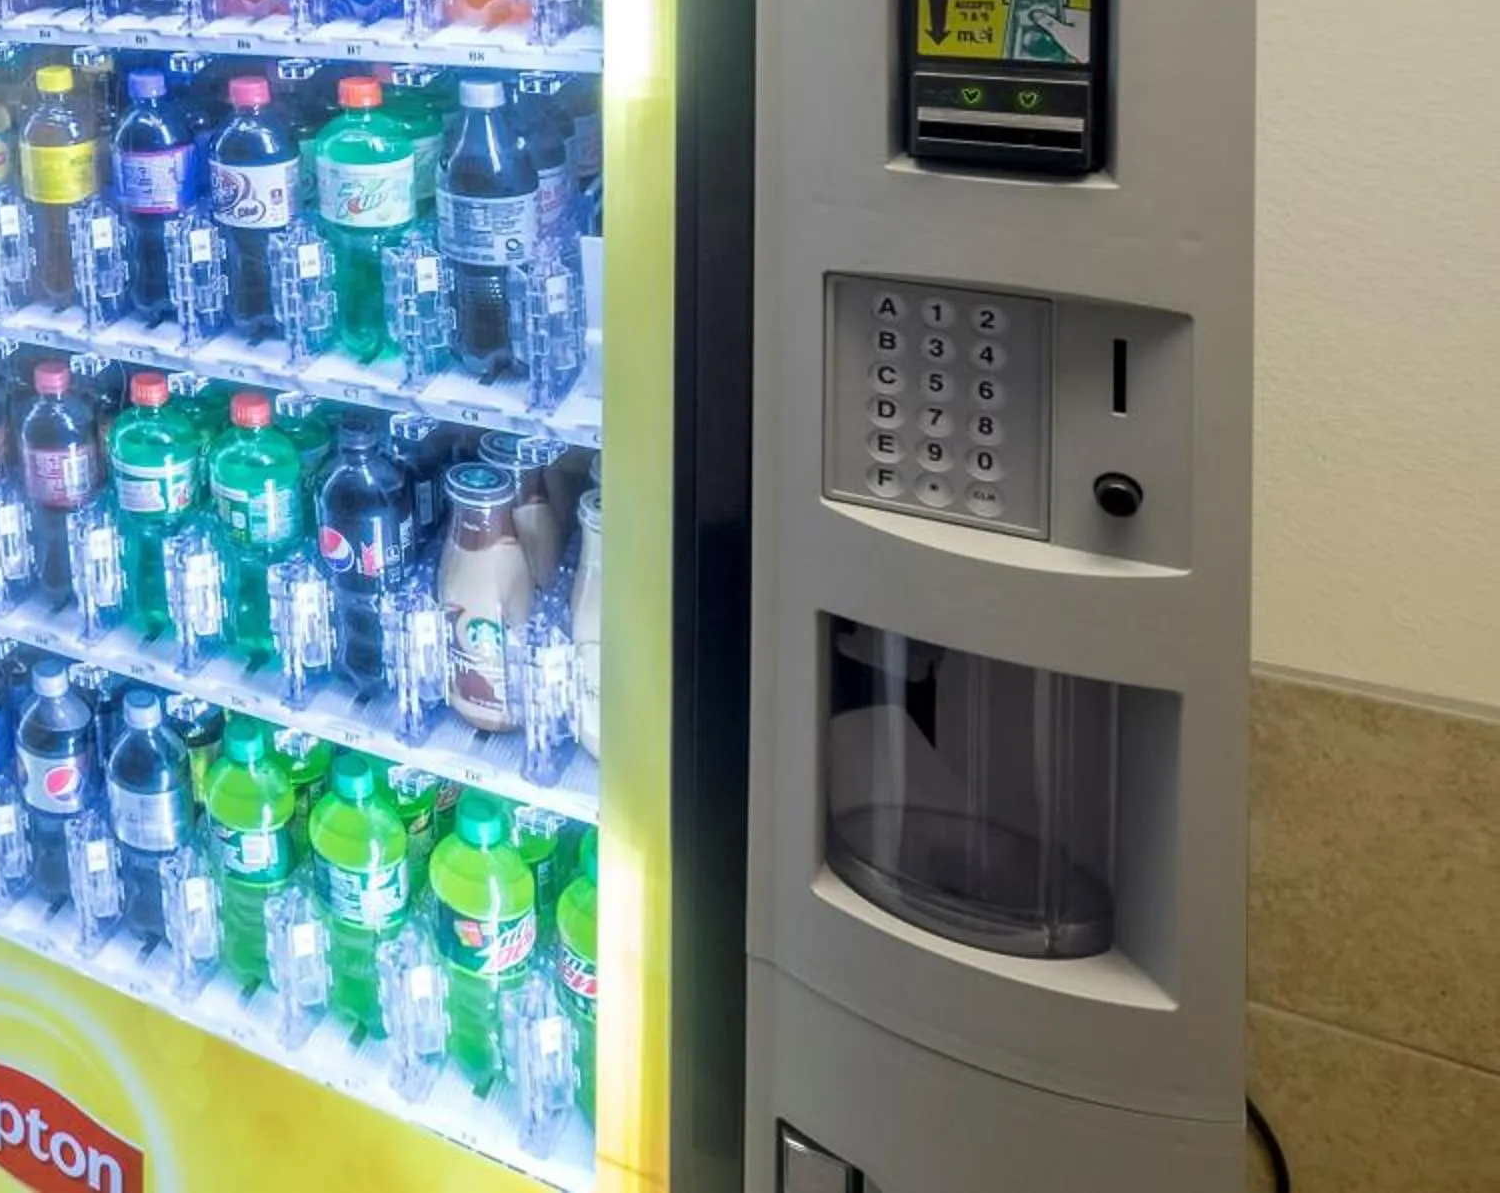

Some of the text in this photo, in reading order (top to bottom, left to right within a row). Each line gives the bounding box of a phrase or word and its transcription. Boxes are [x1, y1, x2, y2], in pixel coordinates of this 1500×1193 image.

[878, 297, 897, 317] A
[931, 305, 942, 322] 1
[979, 311, 996, 329] 2
[878, 332, 897, 350] B
[928, 339, 945, 357] 3
[980, 346, 995, 363] 4
[877, 366, 897, 385] C
[929, 374, 944, 392] 5
[979, 382, 995, 400] 6
[877, 401, 896, 419] D
[929, 409, 944, 426] 7
[978, 417, 994, 435] 8
[878, 435, 894, 454] E
[928, 443, 943, 462] 9
[978, 452, 993, 471] 0
[878, 469, 893, 487] F
